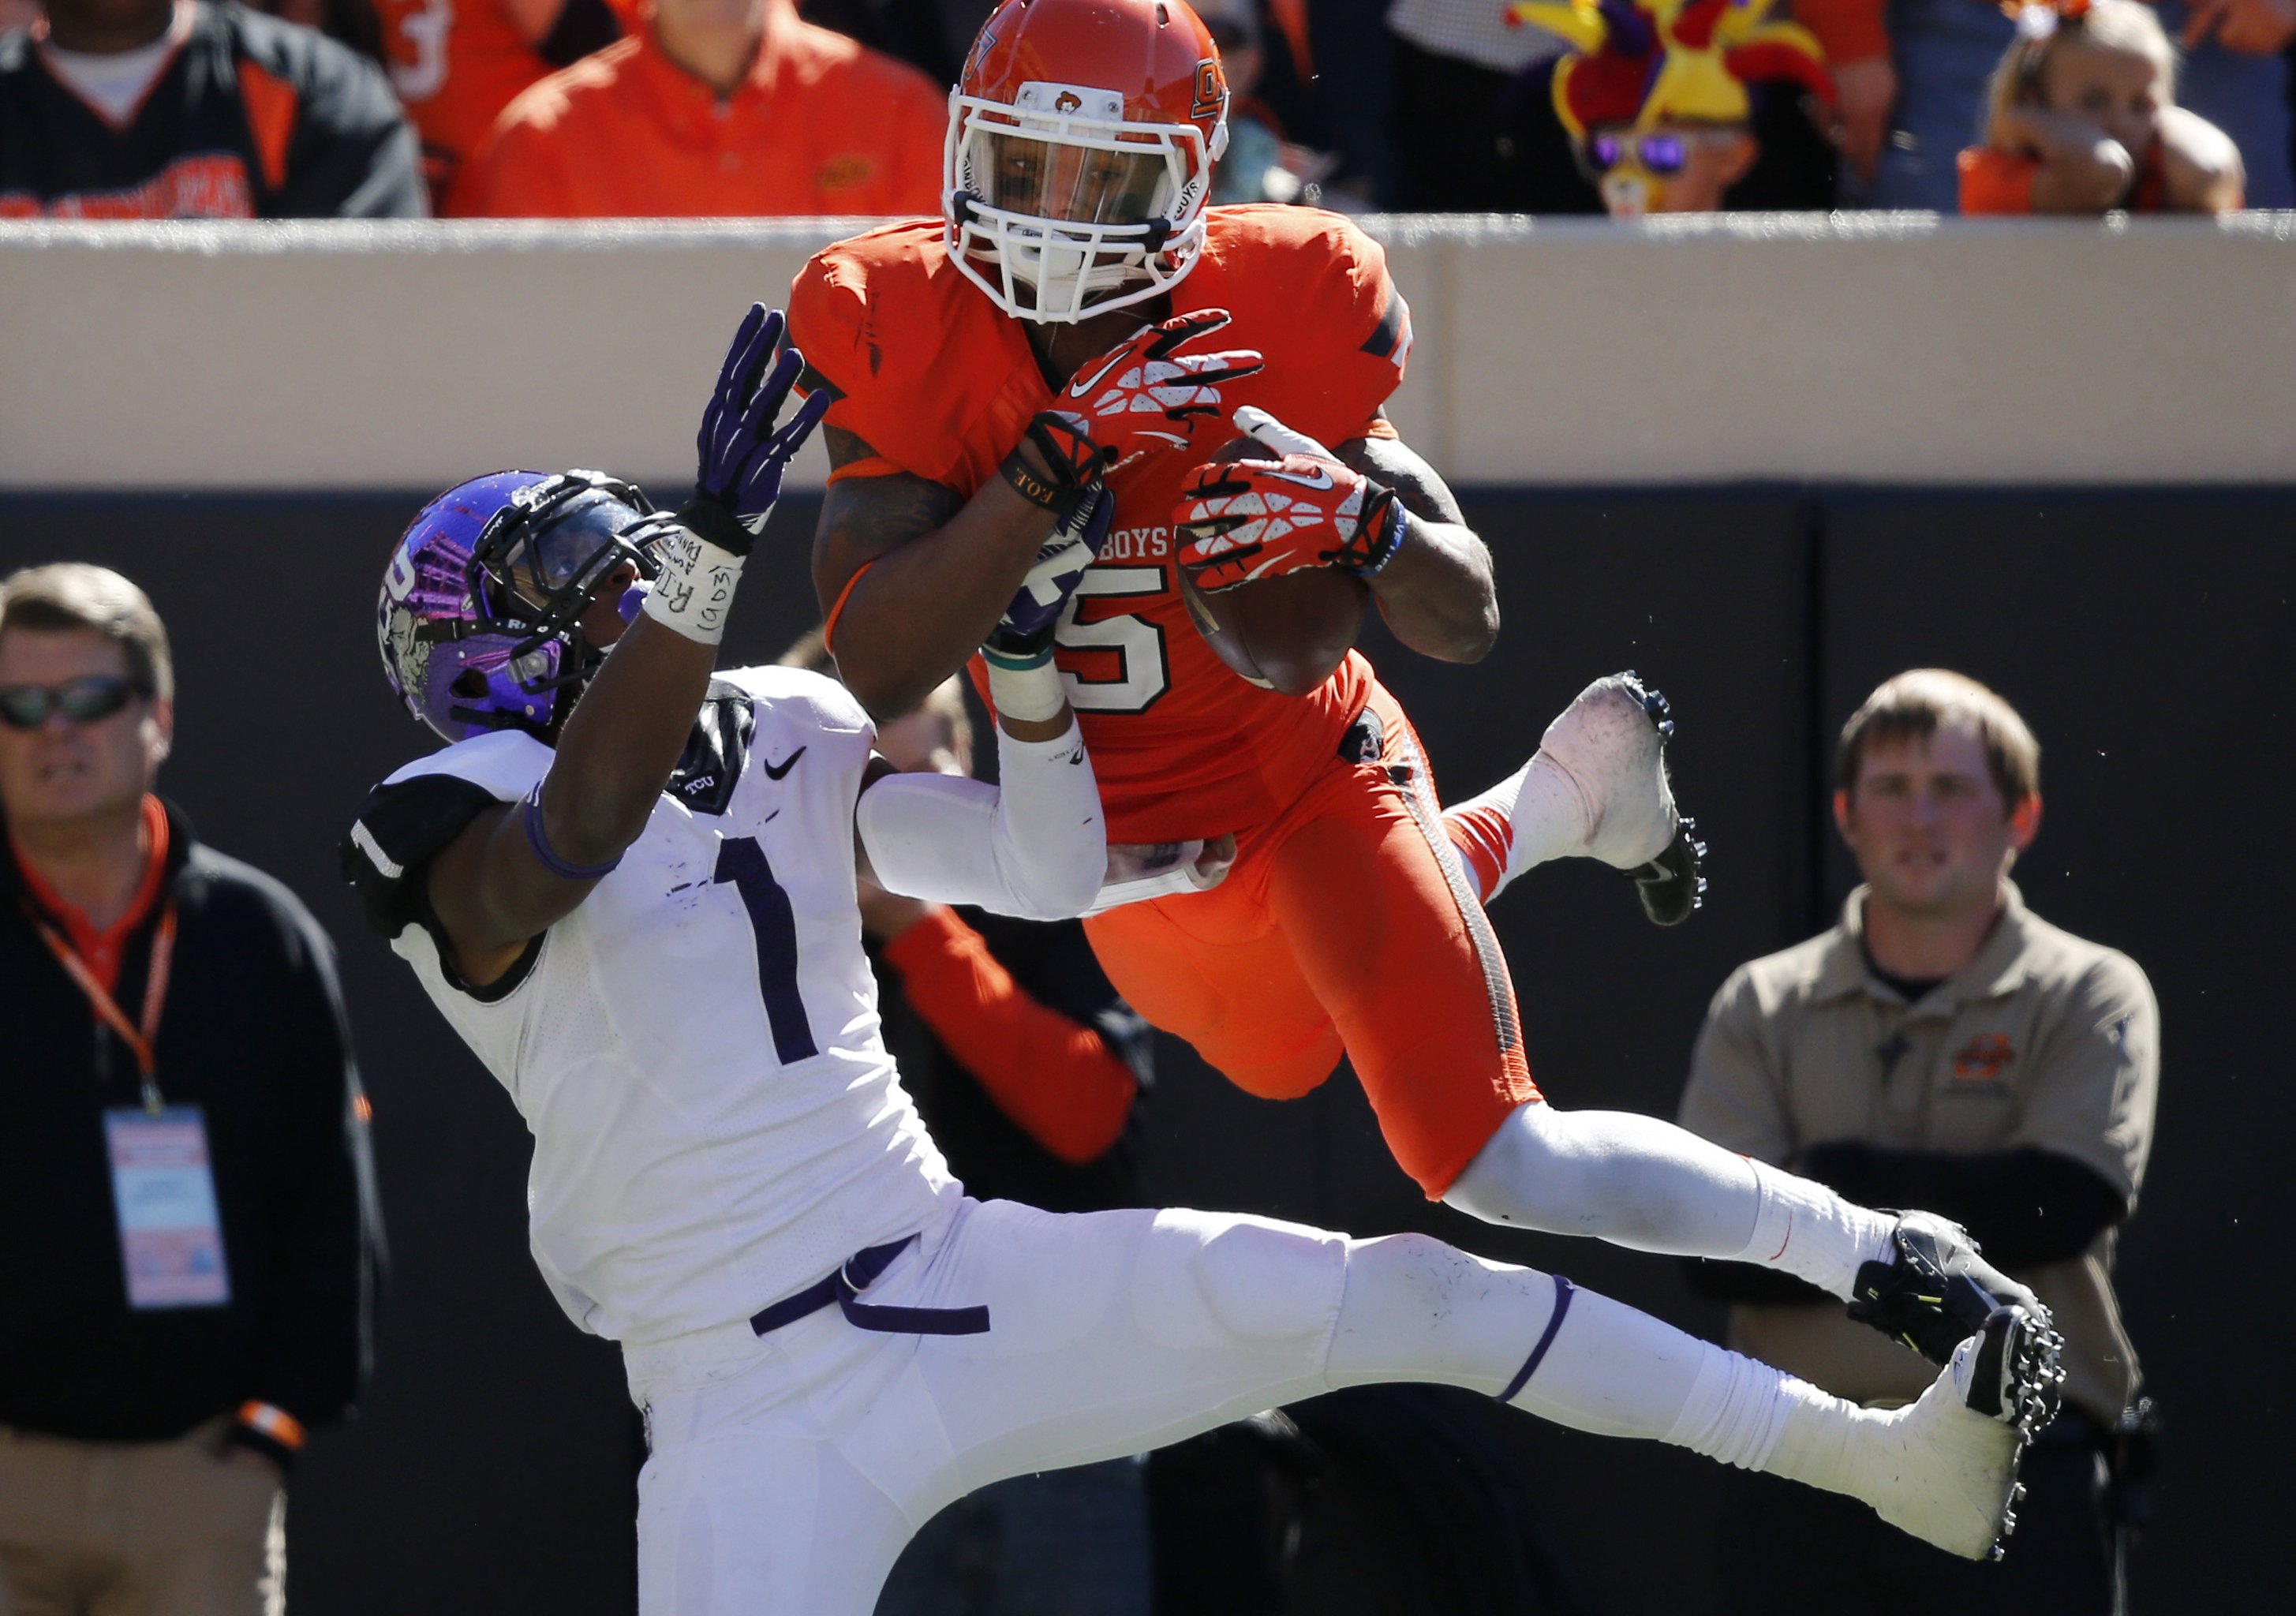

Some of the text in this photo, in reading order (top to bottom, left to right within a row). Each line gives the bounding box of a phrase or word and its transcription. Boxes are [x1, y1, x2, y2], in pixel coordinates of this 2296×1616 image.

[1055, 564, 1172, 716] 5
[684, 776, 715, 795] TCU
[350, 818, 404, 879] 1
[713, 836, 820, 1066] 1
